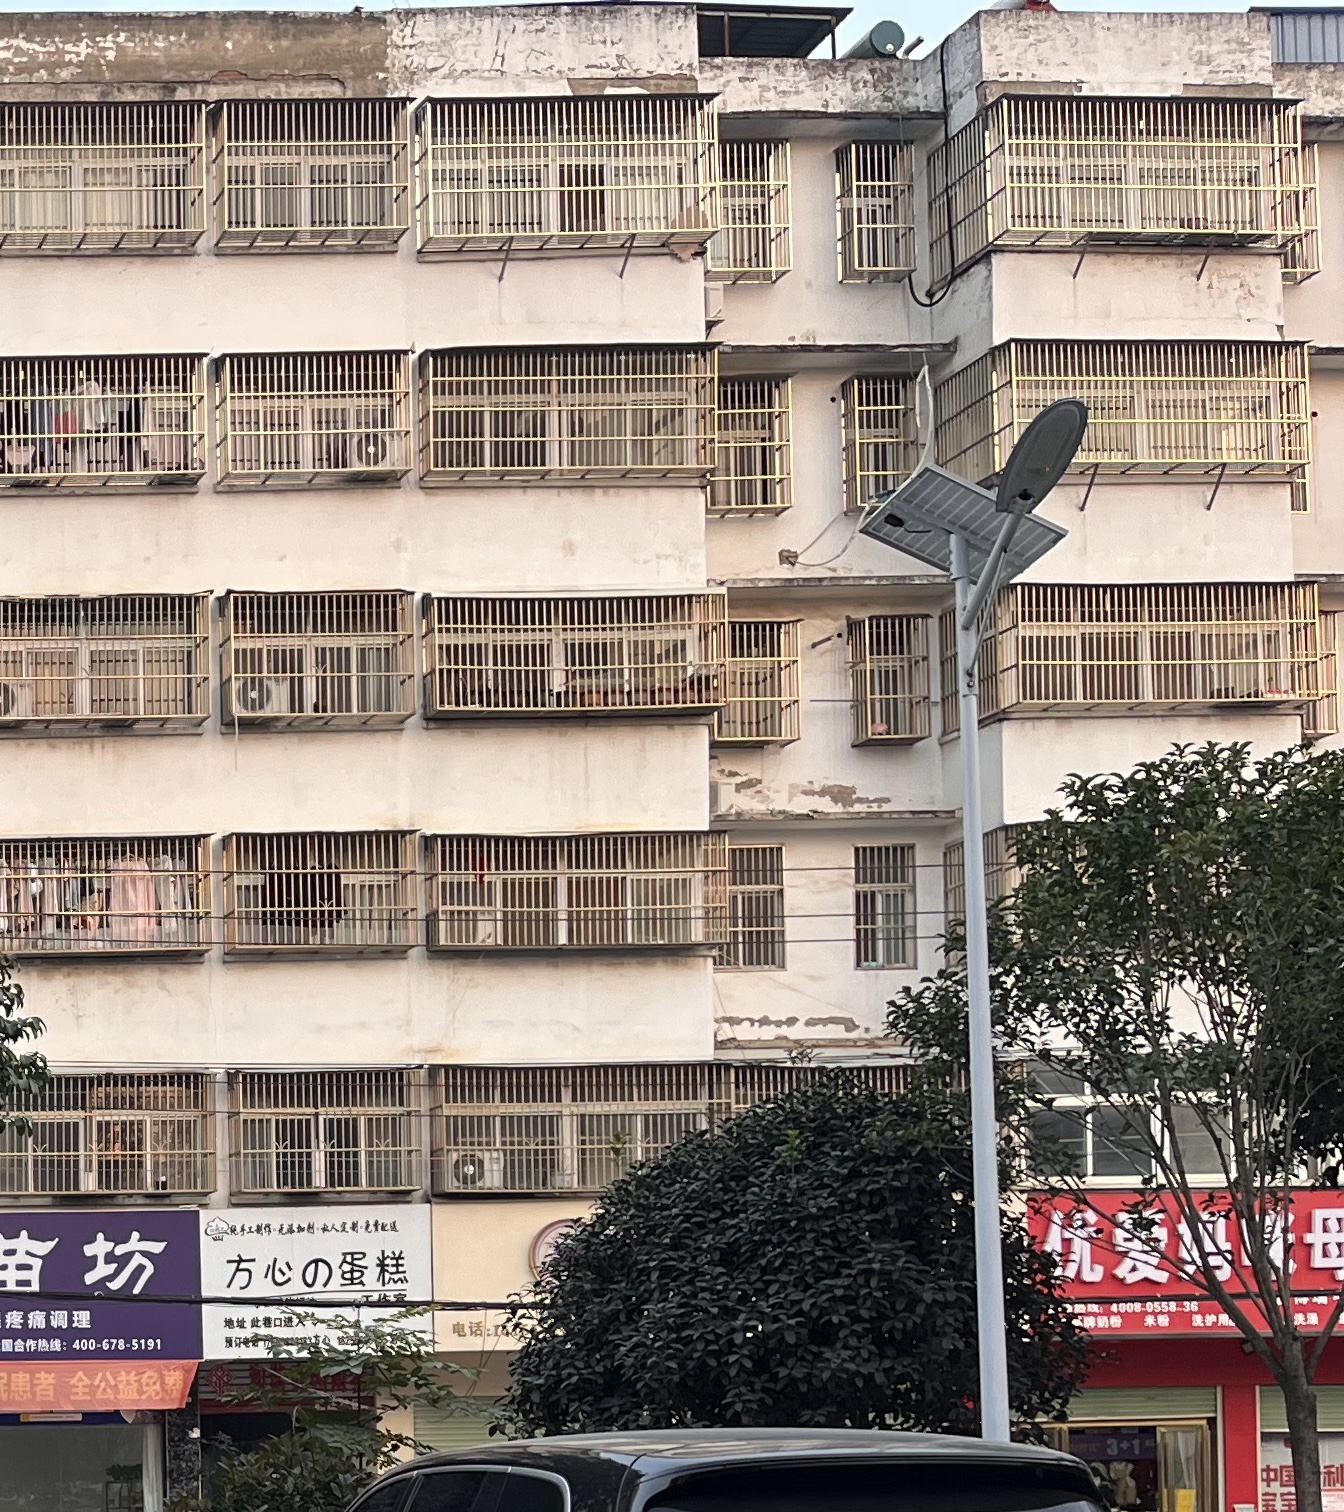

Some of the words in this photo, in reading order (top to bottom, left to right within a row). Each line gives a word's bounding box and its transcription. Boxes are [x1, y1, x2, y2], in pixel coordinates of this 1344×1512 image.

[226, 1250, 409, 1291] 方心の蛋糕
